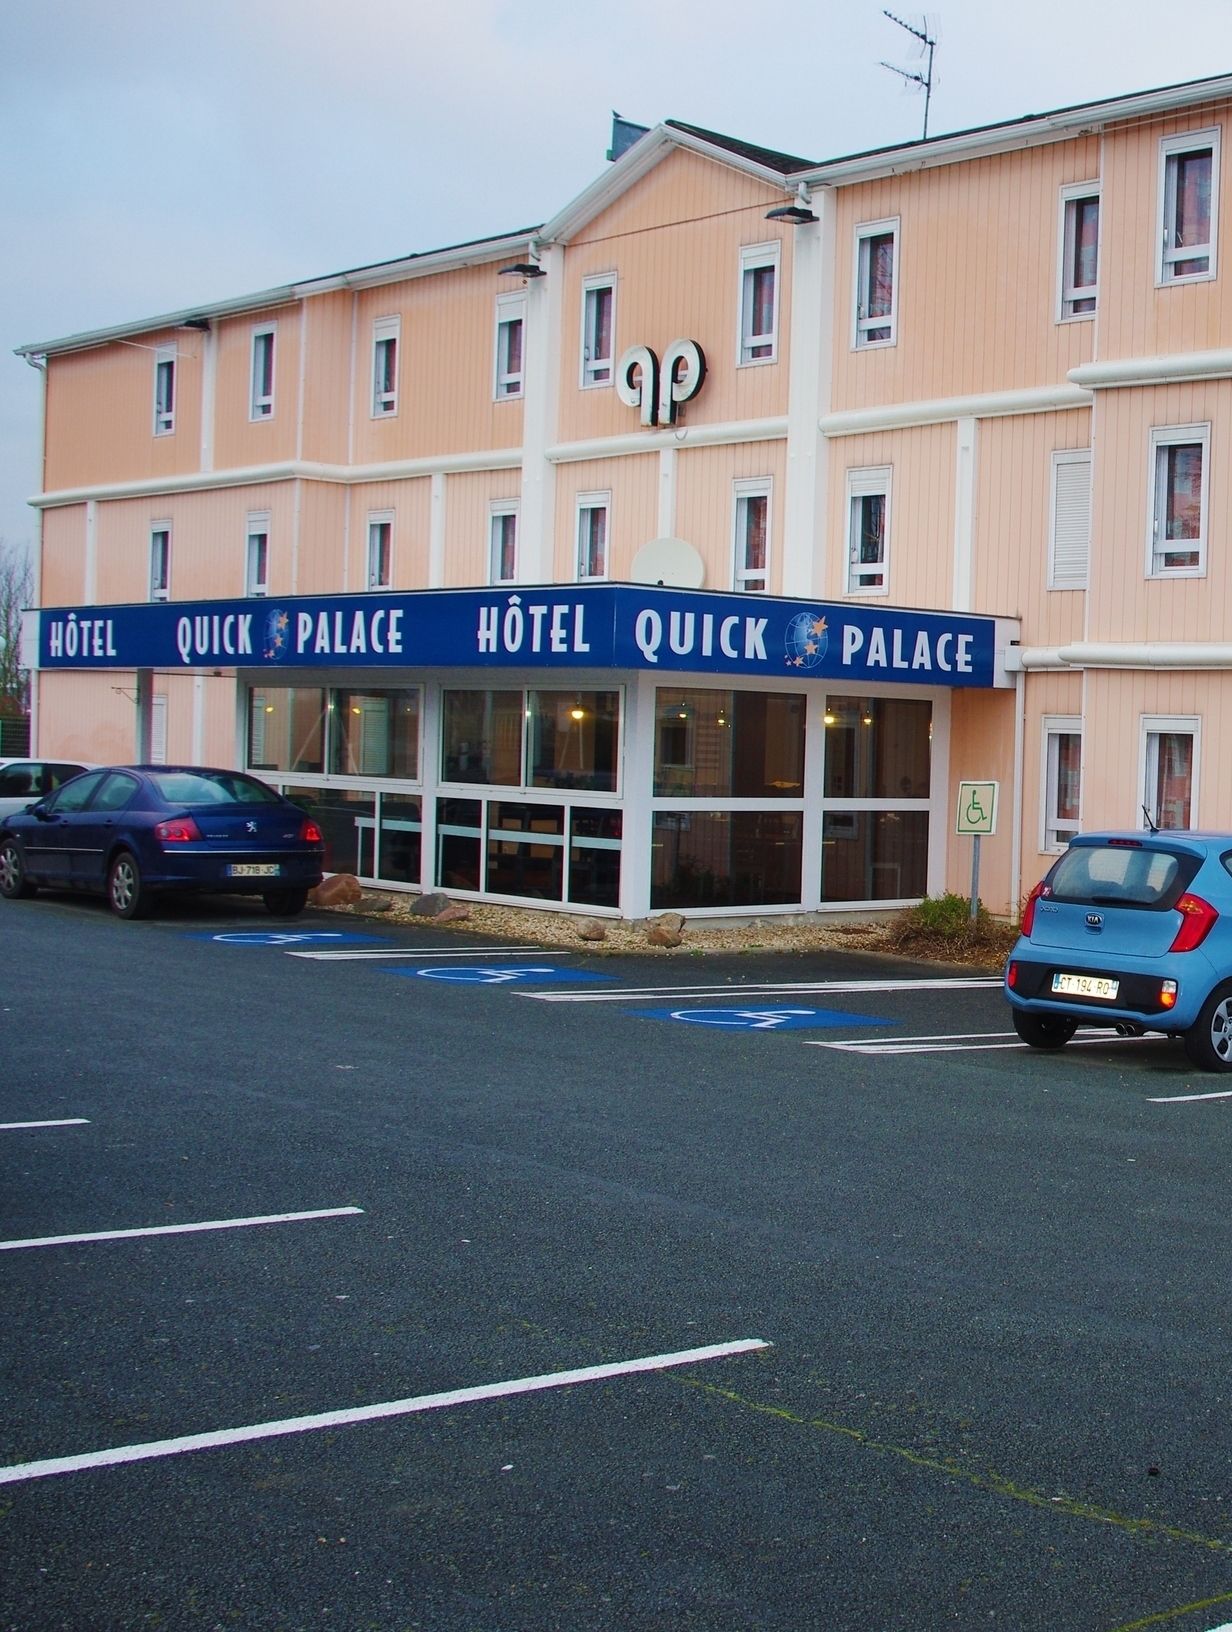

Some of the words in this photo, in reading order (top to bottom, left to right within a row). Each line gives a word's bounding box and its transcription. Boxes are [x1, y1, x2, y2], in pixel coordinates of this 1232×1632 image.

[50, 612, 117, 657] HÔTEL
[177, 614, 253, 664] QUICK
[297, 609, 404, 654] PALACE
[477, 594, 591, 653] HÔTEL
[635, 609, 769, 662] QUICK
[842, 625, 974, 673] PALACE
[1087, 915, 1099, 924] KIA
